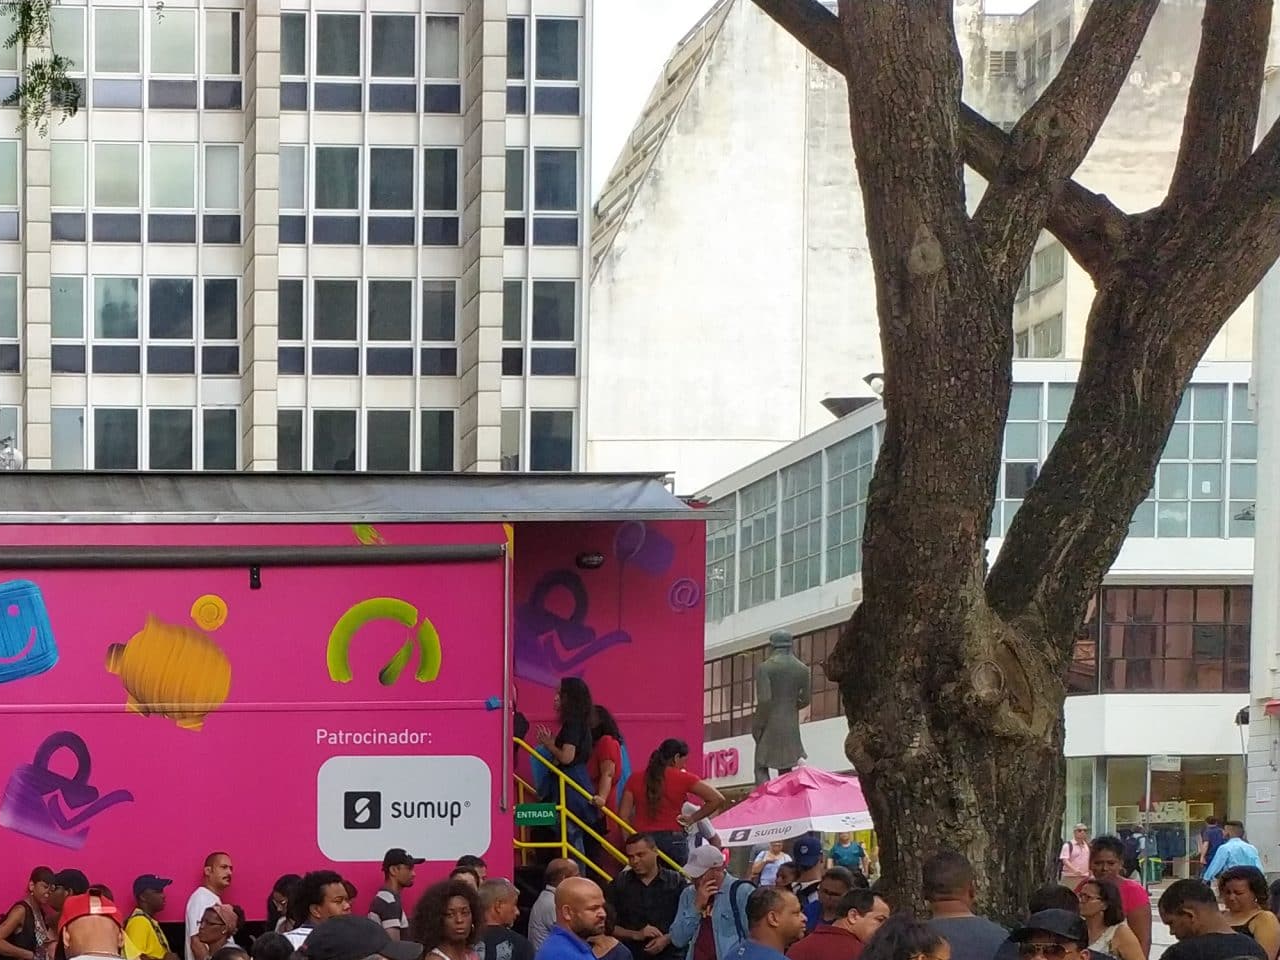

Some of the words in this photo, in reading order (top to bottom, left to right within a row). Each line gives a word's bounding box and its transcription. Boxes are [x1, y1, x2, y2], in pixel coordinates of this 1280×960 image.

[316, 728, 433, 745] Patrocinador:
[516, 810, 554, 819] ENTRADA
[754, 825, 792, 837] sumup
